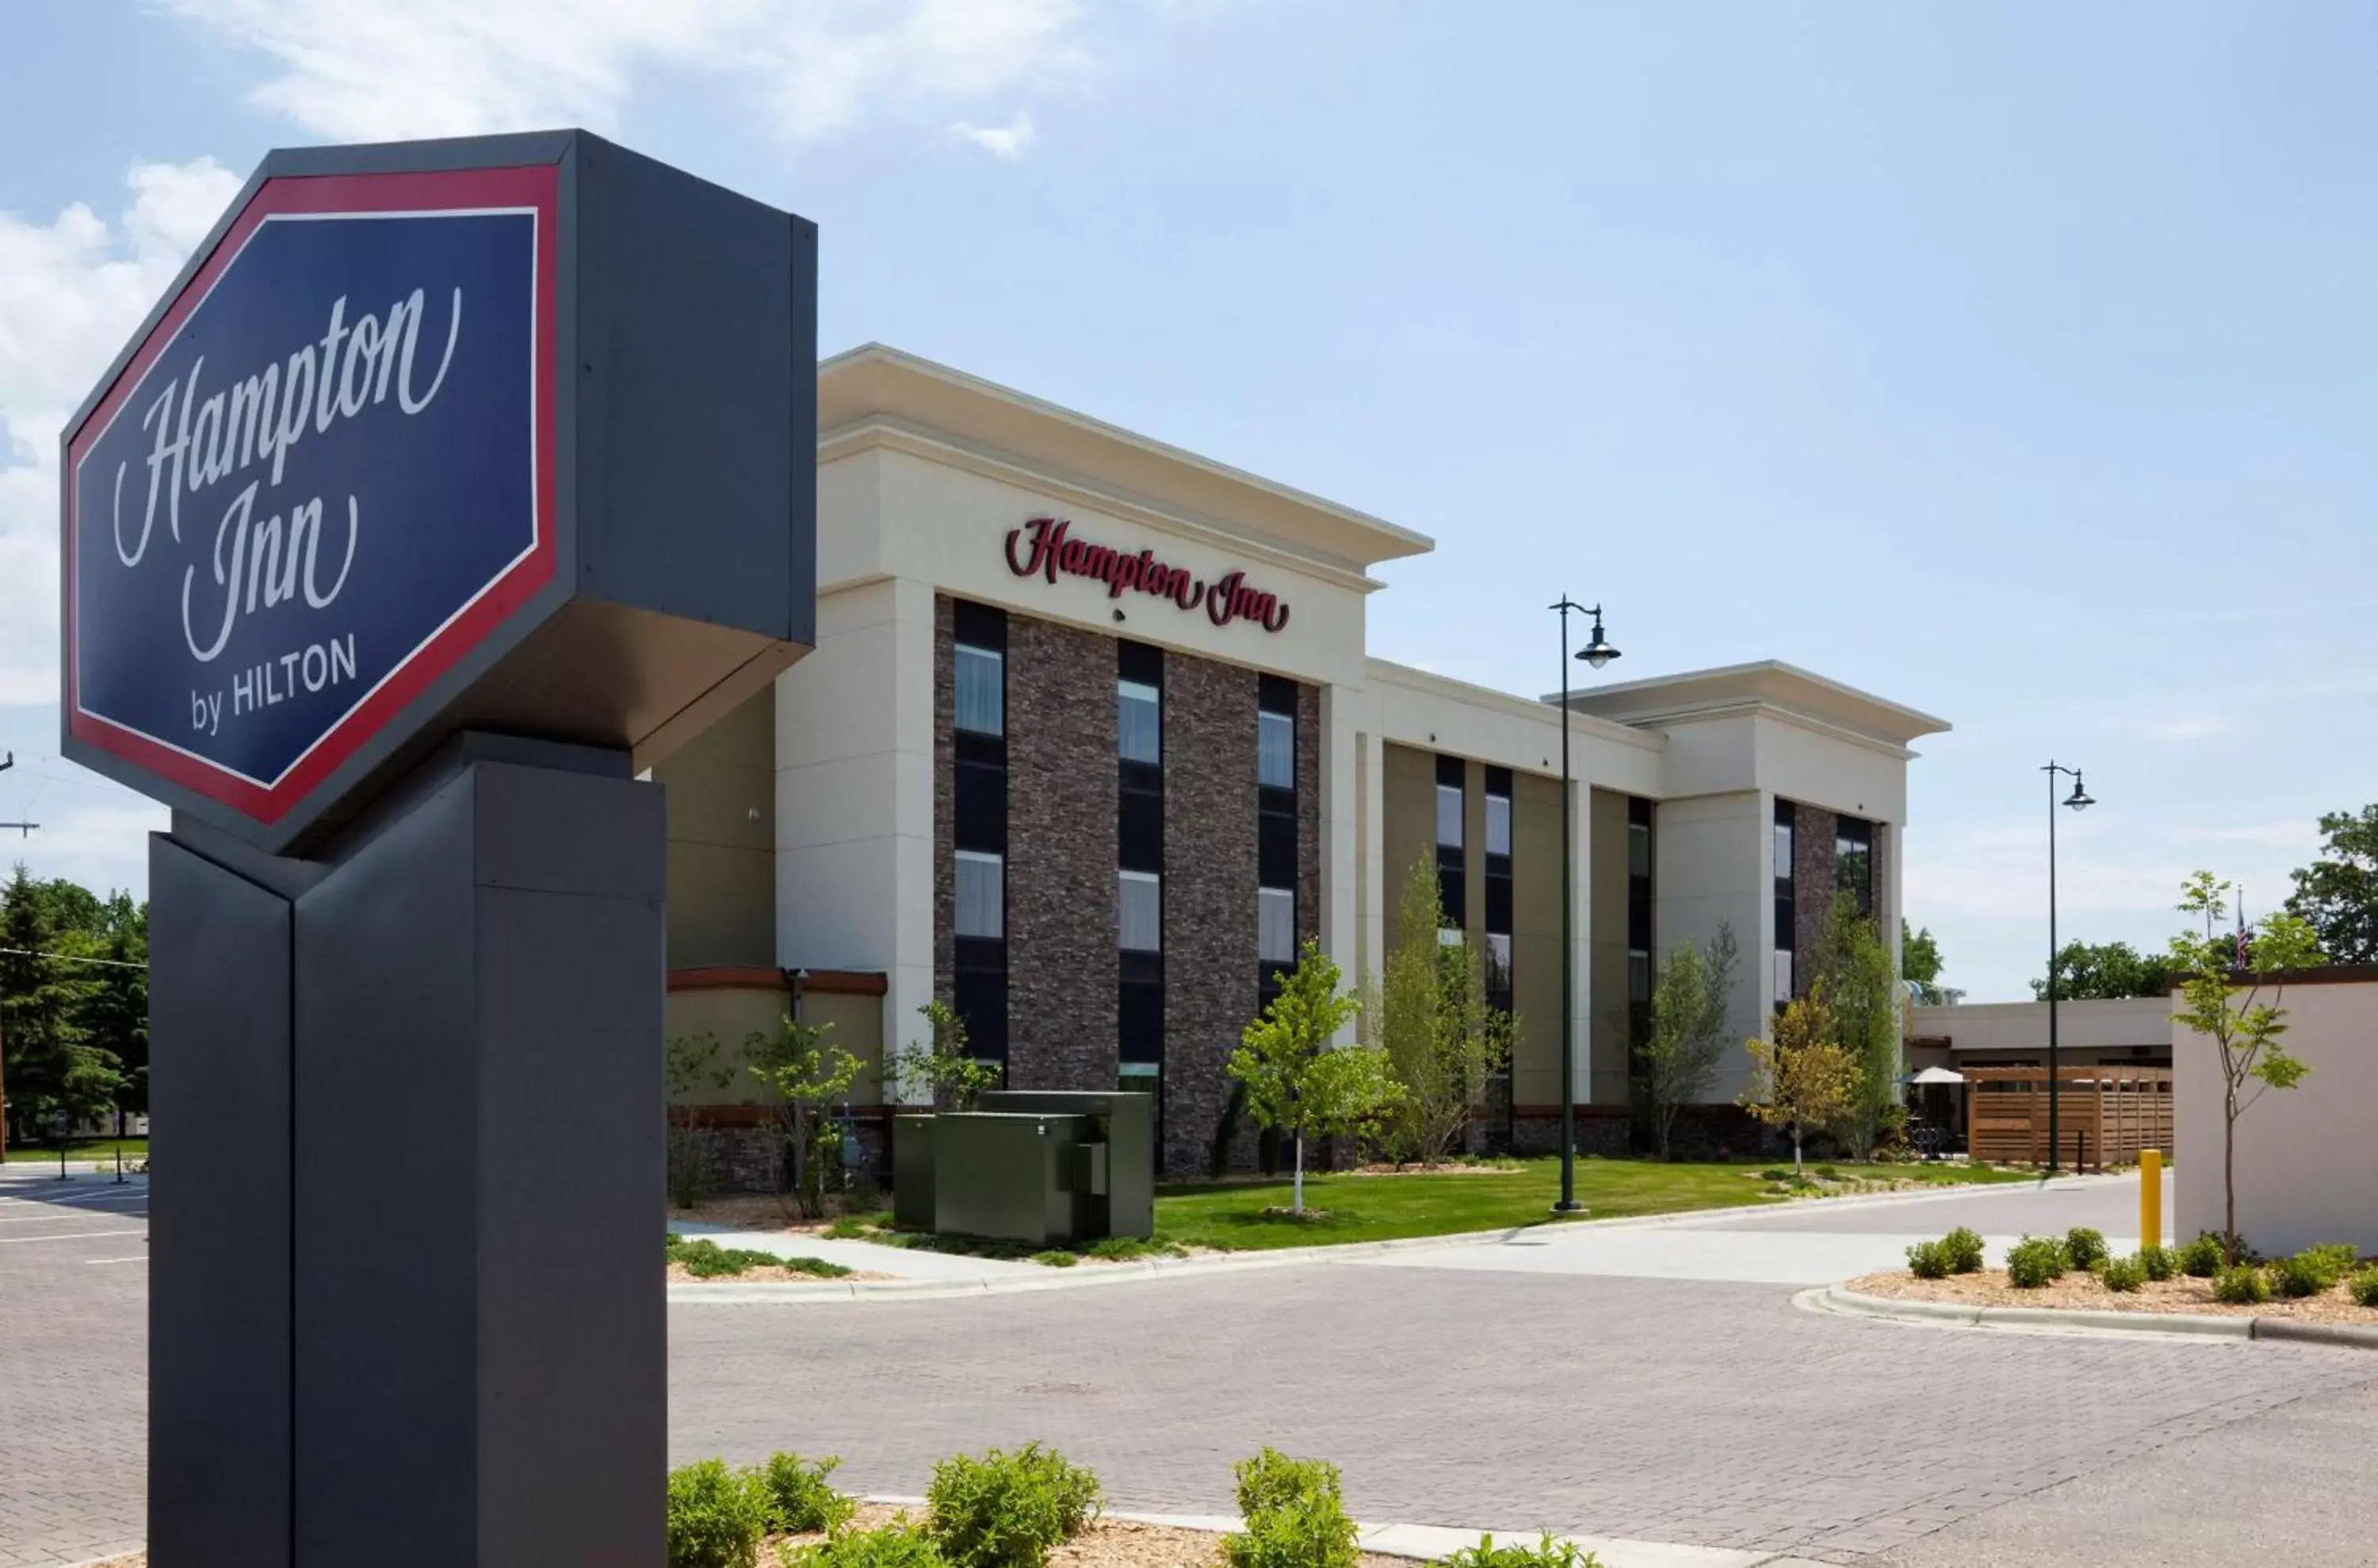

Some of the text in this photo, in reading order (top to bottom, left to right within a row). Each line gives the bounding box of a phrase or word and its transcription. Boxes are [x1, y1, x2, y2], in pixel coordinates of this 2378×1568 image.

[114, 286, 461, 567] Hampton
[182, 480, 358, 662] Inn
[1005, 518, 1289, 633] Hampton Inn
[191, 633, 357, 736] by HILTON
